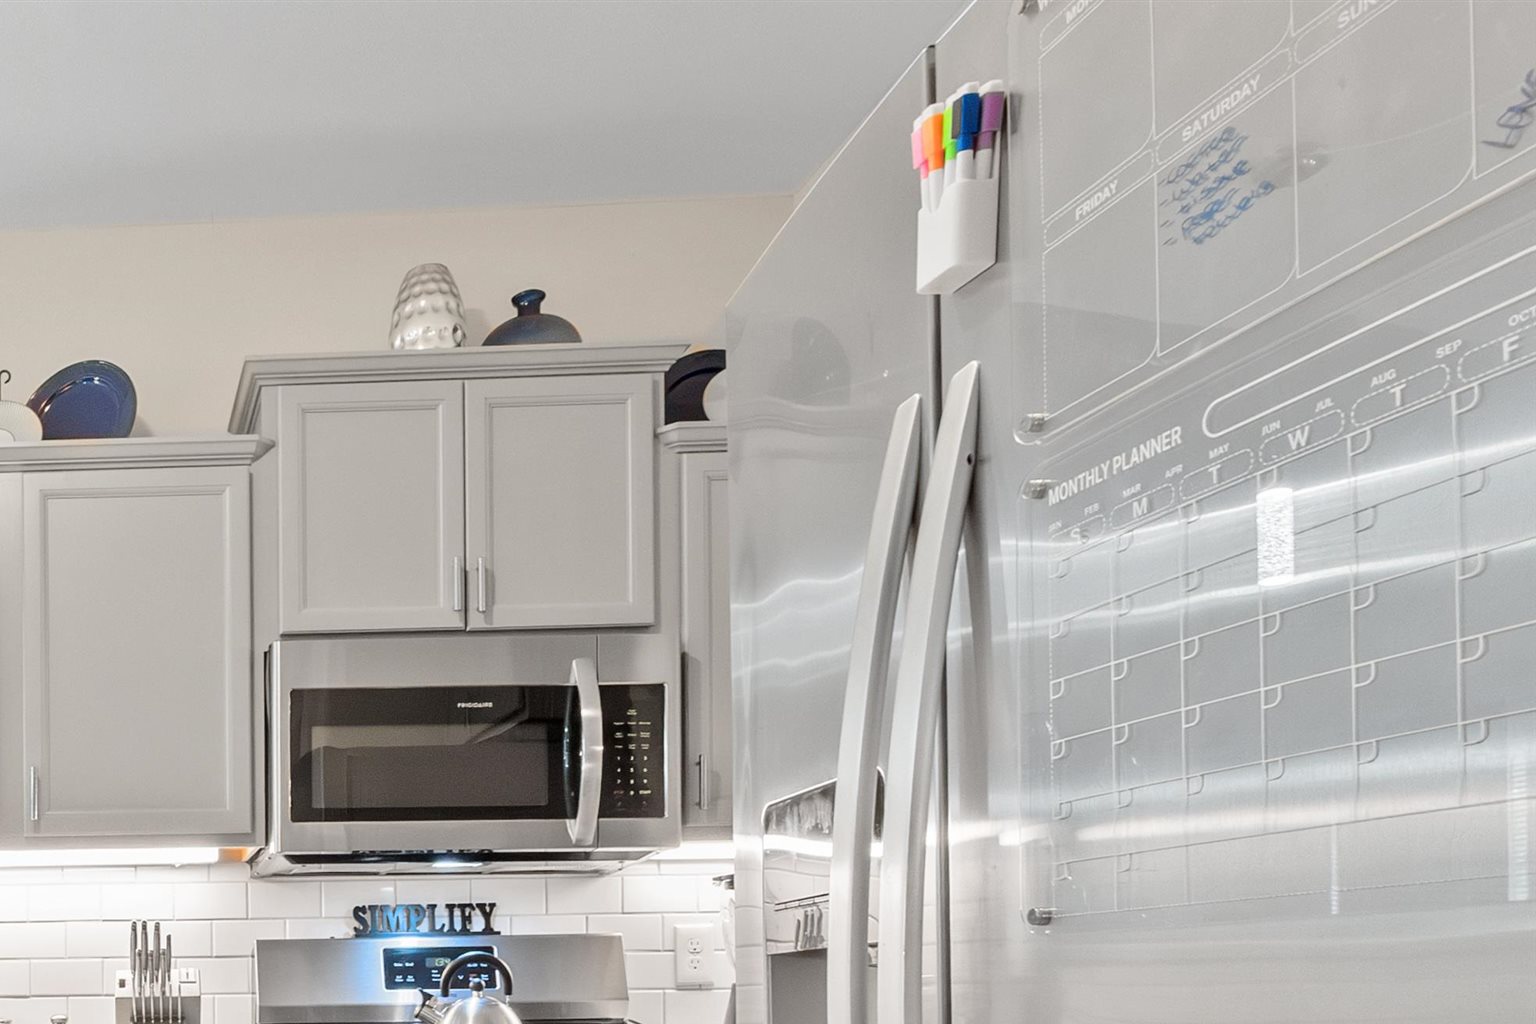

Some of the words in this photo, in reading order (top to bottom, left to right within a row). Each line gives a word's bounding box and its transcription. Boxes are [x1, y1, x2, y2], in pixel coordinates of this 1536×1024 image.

[1181, 74, 1262, 142] SATURDAY
[1075, 179, 1118, 221] FRIDAY
[1084, 503, 1100, 516] FEB
[1122, 483, 1142, 498] MAR
[1165, 464, 1183, 479] APR
[1208, 443, 1230, 460] MAY
[1261, 420, 1281, 436] JUN
[1315, 398, 1334, 413] JUL
[1370, 369, 1397, 388] AUG
[1435, 339, 1462, 359] SEP
[1508, 305, 1536, 327] OCT
[1132, 497, 1148, 518] M
[1208, 464, 1221, 484] T
[1287, 425, 1310, 450] W
[1389, 383, 1407, 407] T
[1502, 335, 1520, 362] F
[1048, 460, 1111, 506] MONTHLY
[1112, 426, 1182, 475] PLANNER
[352, 902, 497, 933] SIMPLIFY
